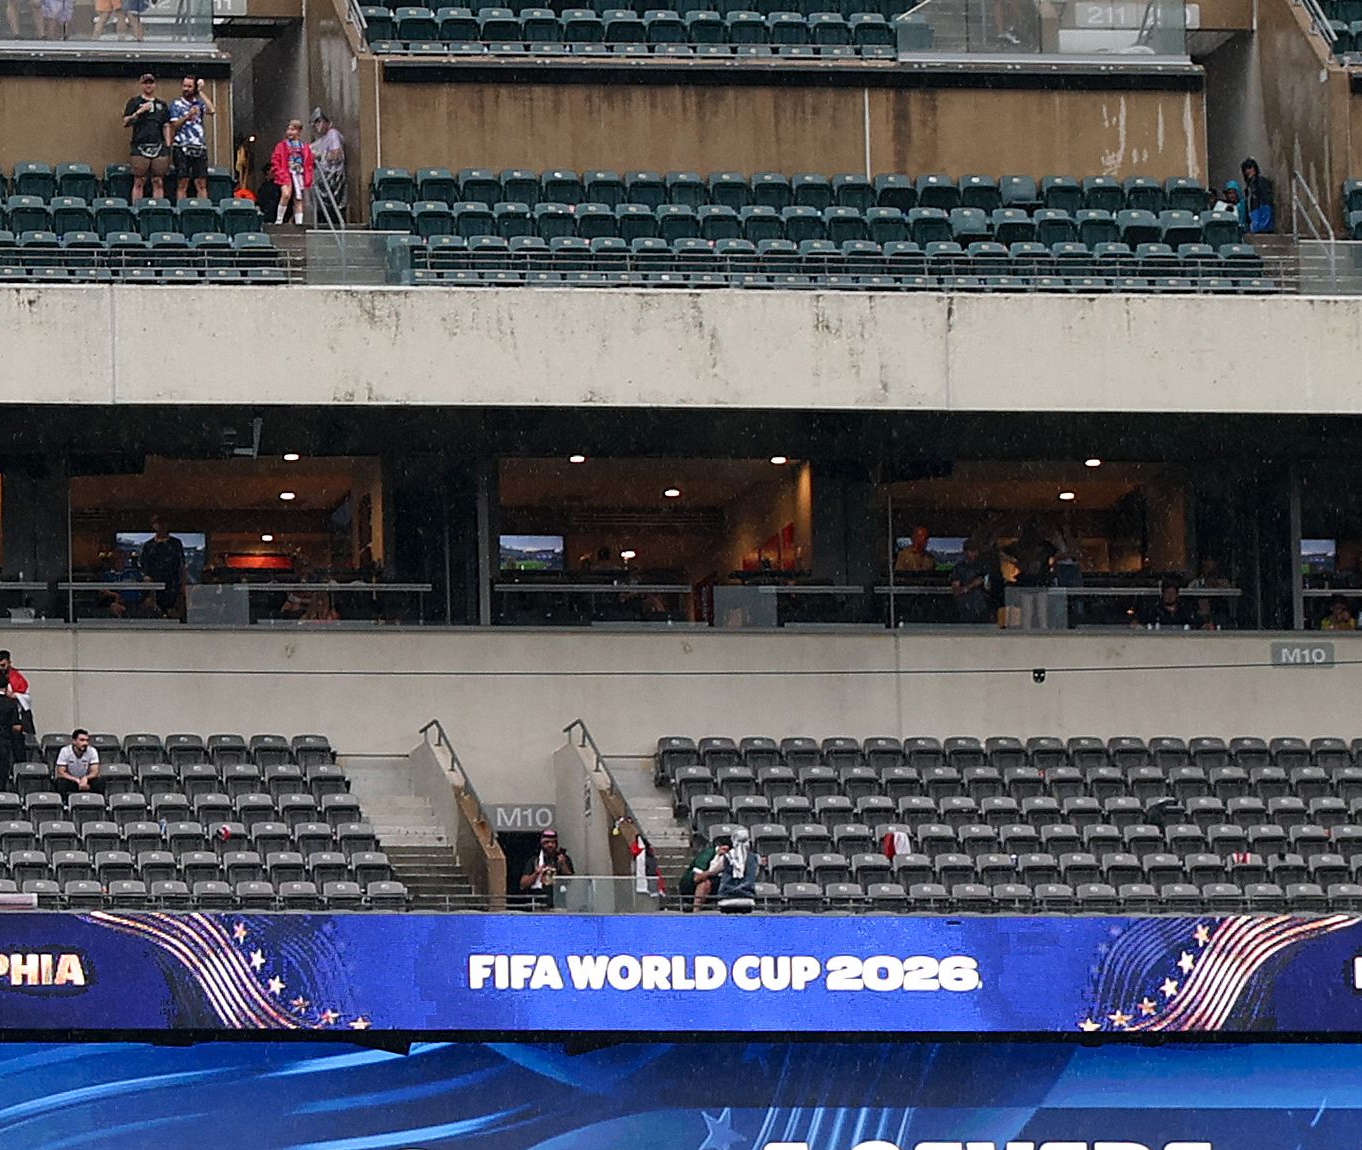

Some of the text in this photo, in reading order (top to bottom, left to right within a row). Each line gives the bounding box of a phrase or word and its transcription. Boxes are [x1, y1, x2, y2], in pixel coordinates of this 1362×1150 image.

[1087, 6, 1125, 24] 211
[1281, 648, 1326, 663] M10
[497, 807, 553, 827] M10
[469, 954, 979, 992] FIFA WORLD CUP 2026
